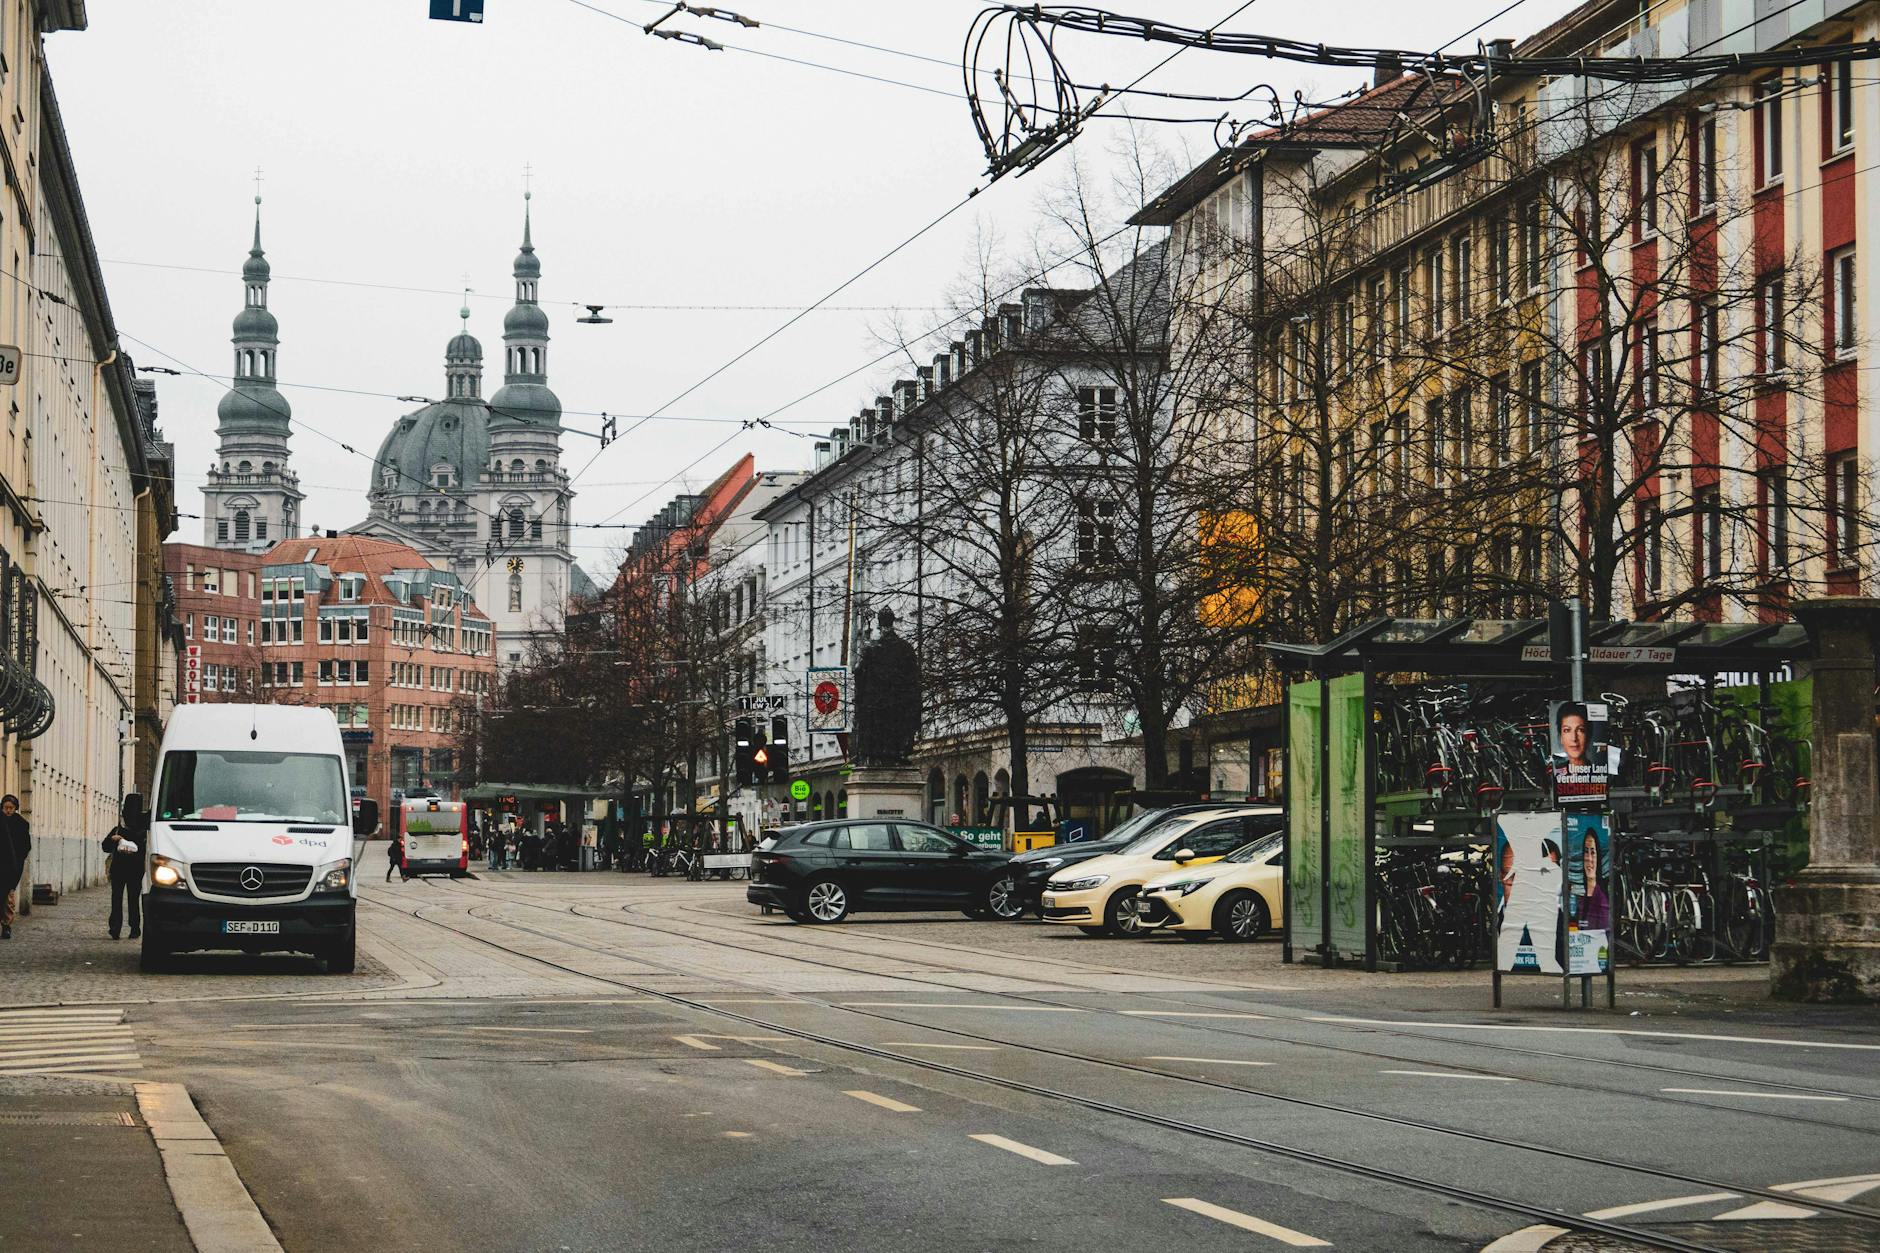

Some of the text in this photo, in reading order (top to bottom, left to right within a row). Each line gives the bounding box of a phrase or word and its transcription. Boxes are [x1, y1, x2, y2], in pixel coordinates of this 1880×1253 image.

[1648, 649, 1673, 661] Tage
[1568, 763, 1608, 773] Unser Land
[1591, 774, 1608, 783] mehr
[1556, 784, 1607, 795] SICHERHEIT
[960, 831, 1001, 842] So geht
[299, 837, 327, 848] dpd
